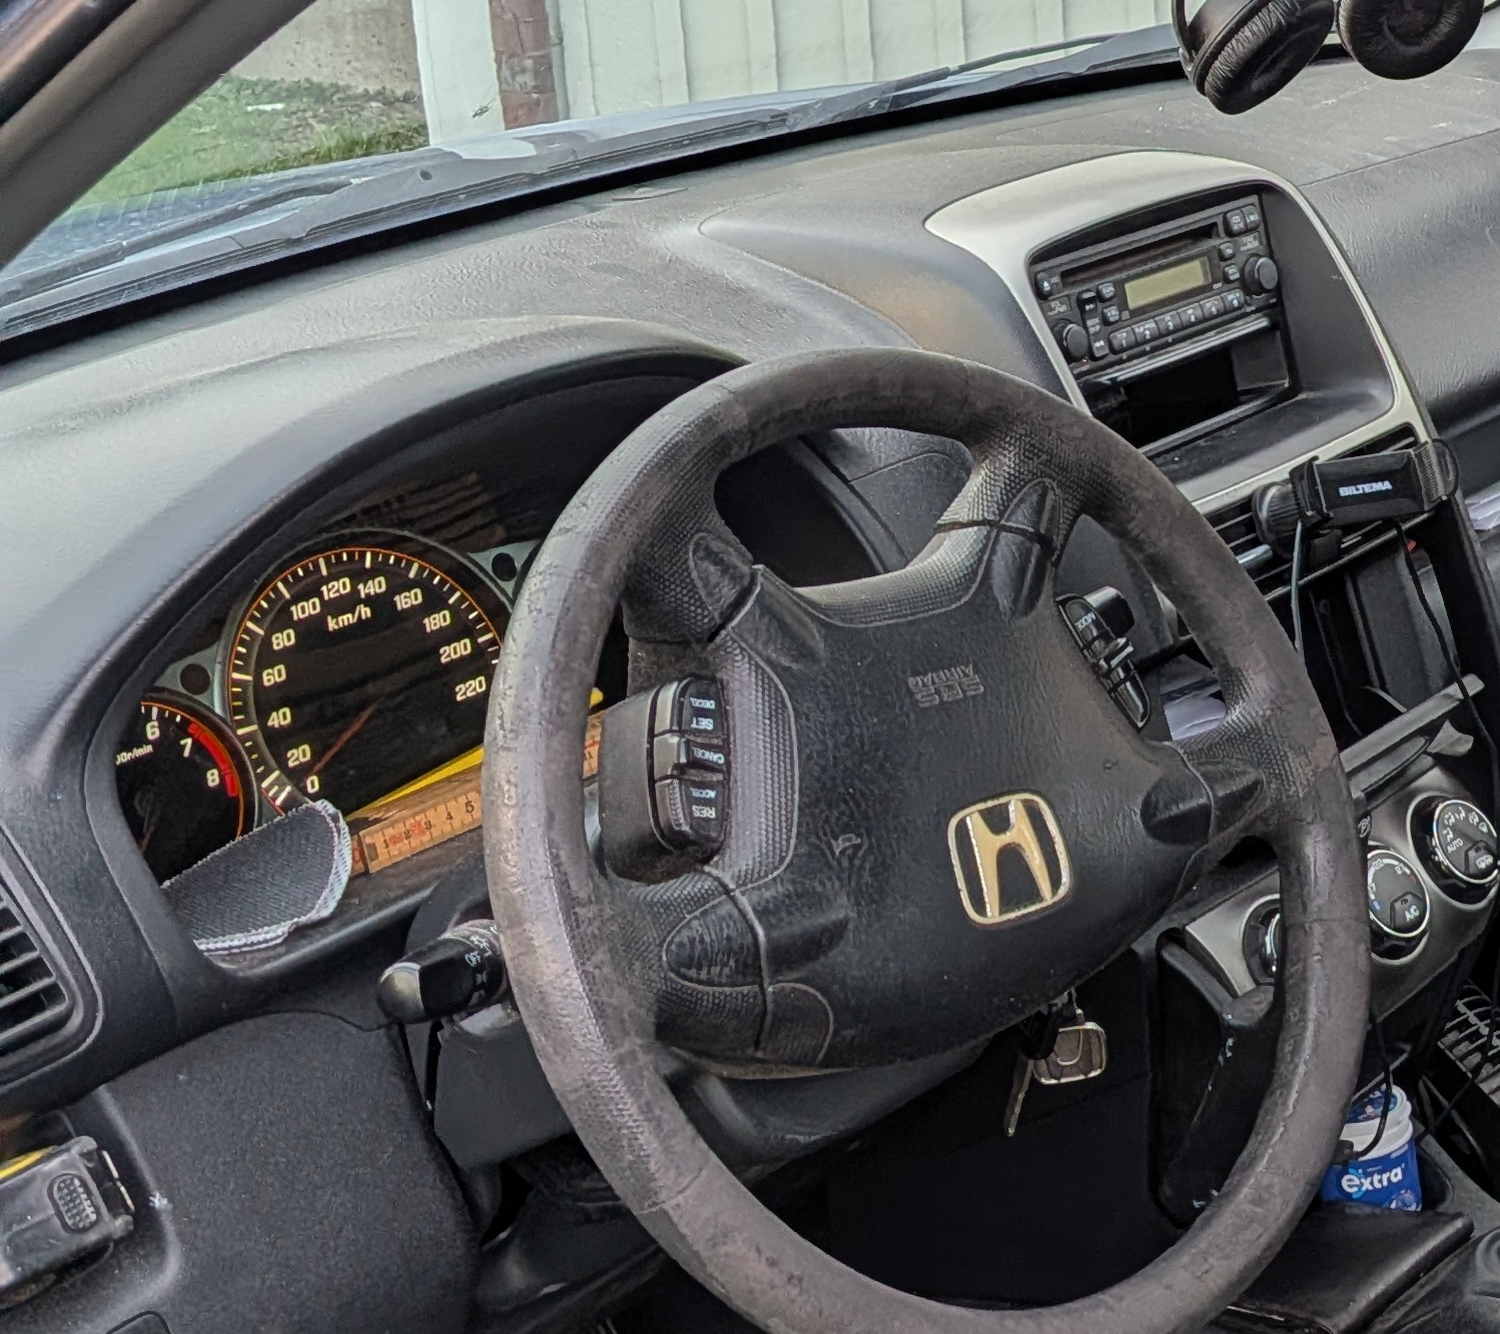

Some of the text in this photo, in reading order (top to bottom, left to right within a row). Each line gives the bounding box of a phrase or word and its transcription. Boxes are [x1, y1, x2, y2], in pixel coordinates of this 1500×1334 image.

[1338, 480, 1393, 496] BILTEMA
[321, 577, 351, 600] 120
[357, 576, 386, 598] 140
[289, 596, 320, 620] 100
[394, 588, 422, 610] 160
[327, 604, 371, 631] km/h
[423, 610, 450, 632] 180
[272, 629, 295, 650] 80
[440, 639, 471, 663] 200
[262, 665, 286, 686] 60
[455, 676, 486, 701] 220
[268, 708, 291, 727] 40
[690, 717, 714, 730] SET
[146, 721, 160, 740] 6
[180, 738, 192, 757] 7
[287, 744, 310, 767] 20
[692, 747, 725, 764] CANCEL
[207, 769, 219, 787] 8
[306, 775, 319, 793] 0
[446, 811, 454, 821] 4
[465, 800, 475, 814] 5
[691, 805, 716, 819] RES
[1446, 837, 1464, 854] AUTO
[1404, 905, 1420, 922] A/C
[1341, 1166, 1403, 1193] extra
